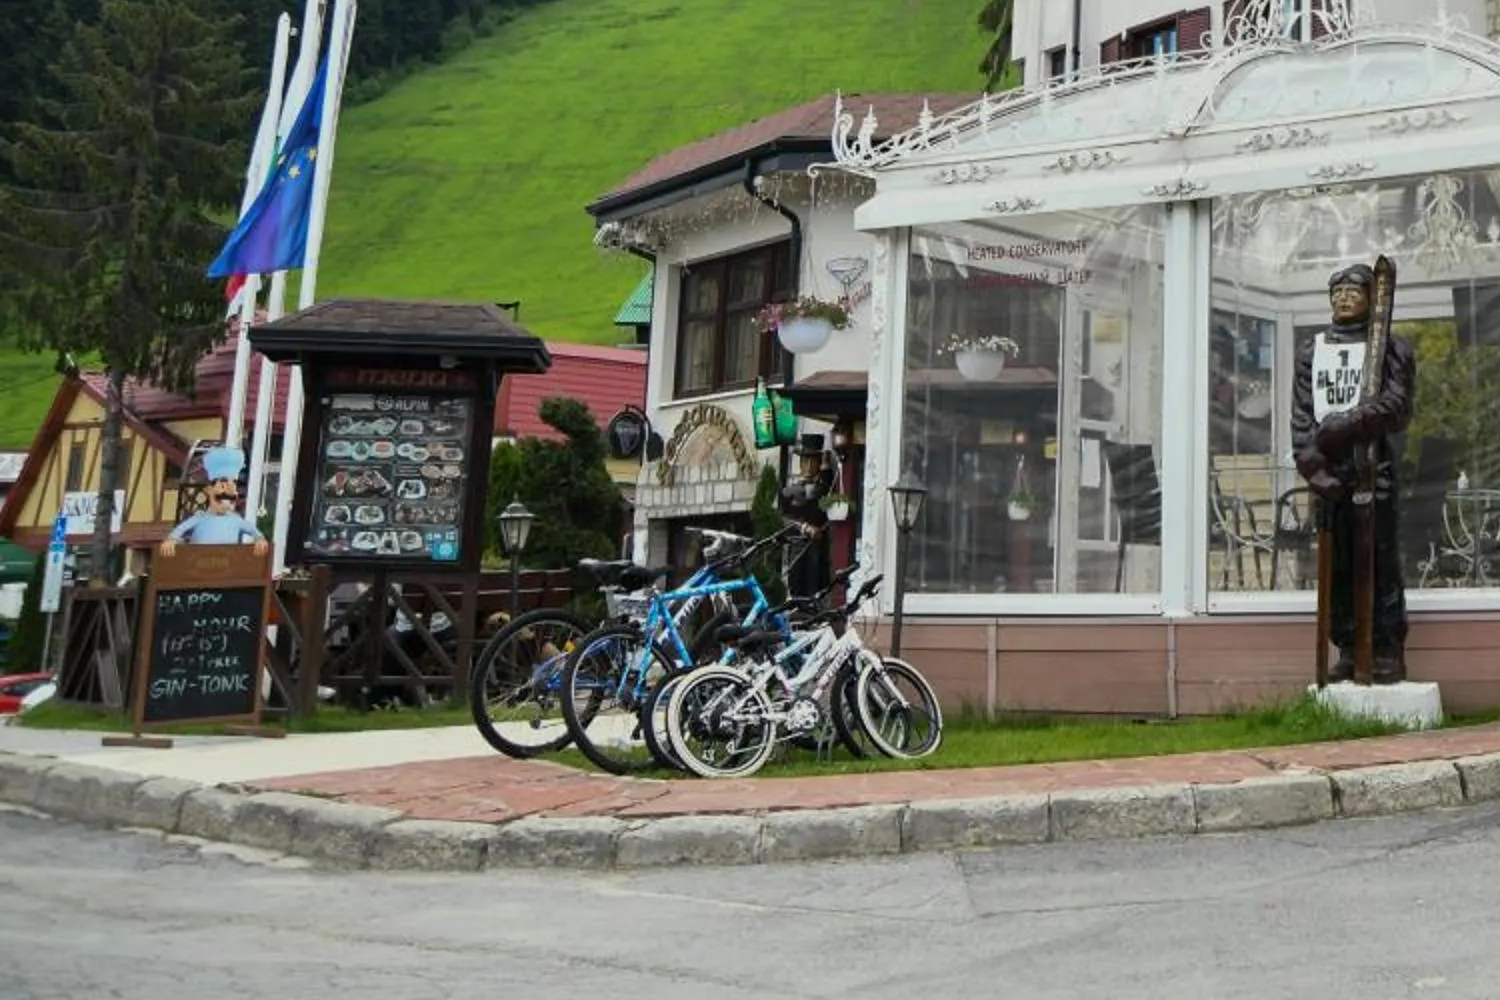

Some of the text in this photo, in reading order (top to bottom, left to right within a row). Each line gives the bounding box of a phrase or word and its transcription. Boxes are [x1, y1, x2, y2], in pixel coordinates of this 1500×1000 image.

[1337, 349, 1349, 366] 1
[1316, 367, 1362, 389] ALPIN
[1326, 385, 1357, 405] CUP
